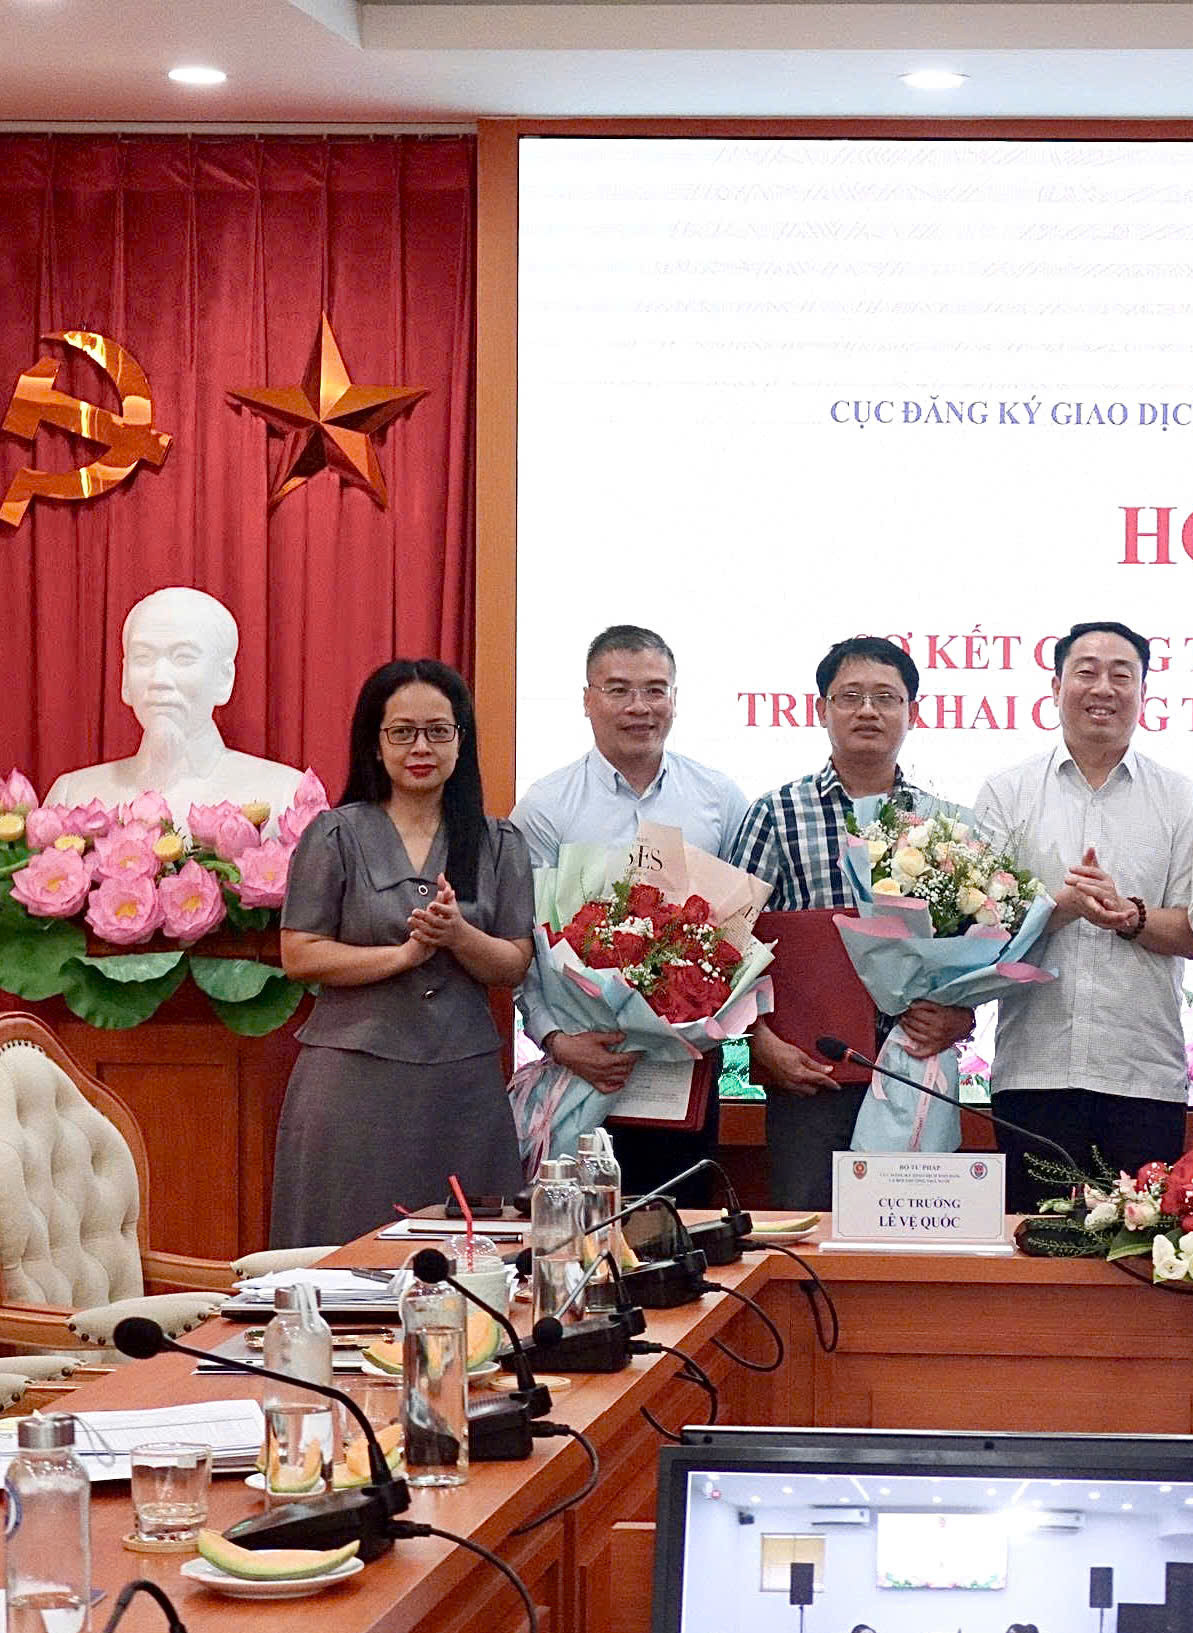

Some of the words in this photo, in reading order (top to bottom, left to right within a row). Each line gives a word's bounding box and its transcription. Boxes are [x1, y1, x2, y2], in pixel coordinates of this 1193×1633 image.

[830, 400, 894, 429] CỤC
[901, 394, 989, 424] ĐĂNG
[998, 395, 1042, 425] KÝ
[1050, 402, 1128, 426] GIAO
[924, 624, 1022, 670] KẾT
[1034, 635, 1173, 673] CG
[1031, 695, 1170, 732] CG
[878, 1197, 905, 1210] CỤC
[879, 1212, 896, 1227] LÊ
[899, 1214, 918, 1230] VỆ
